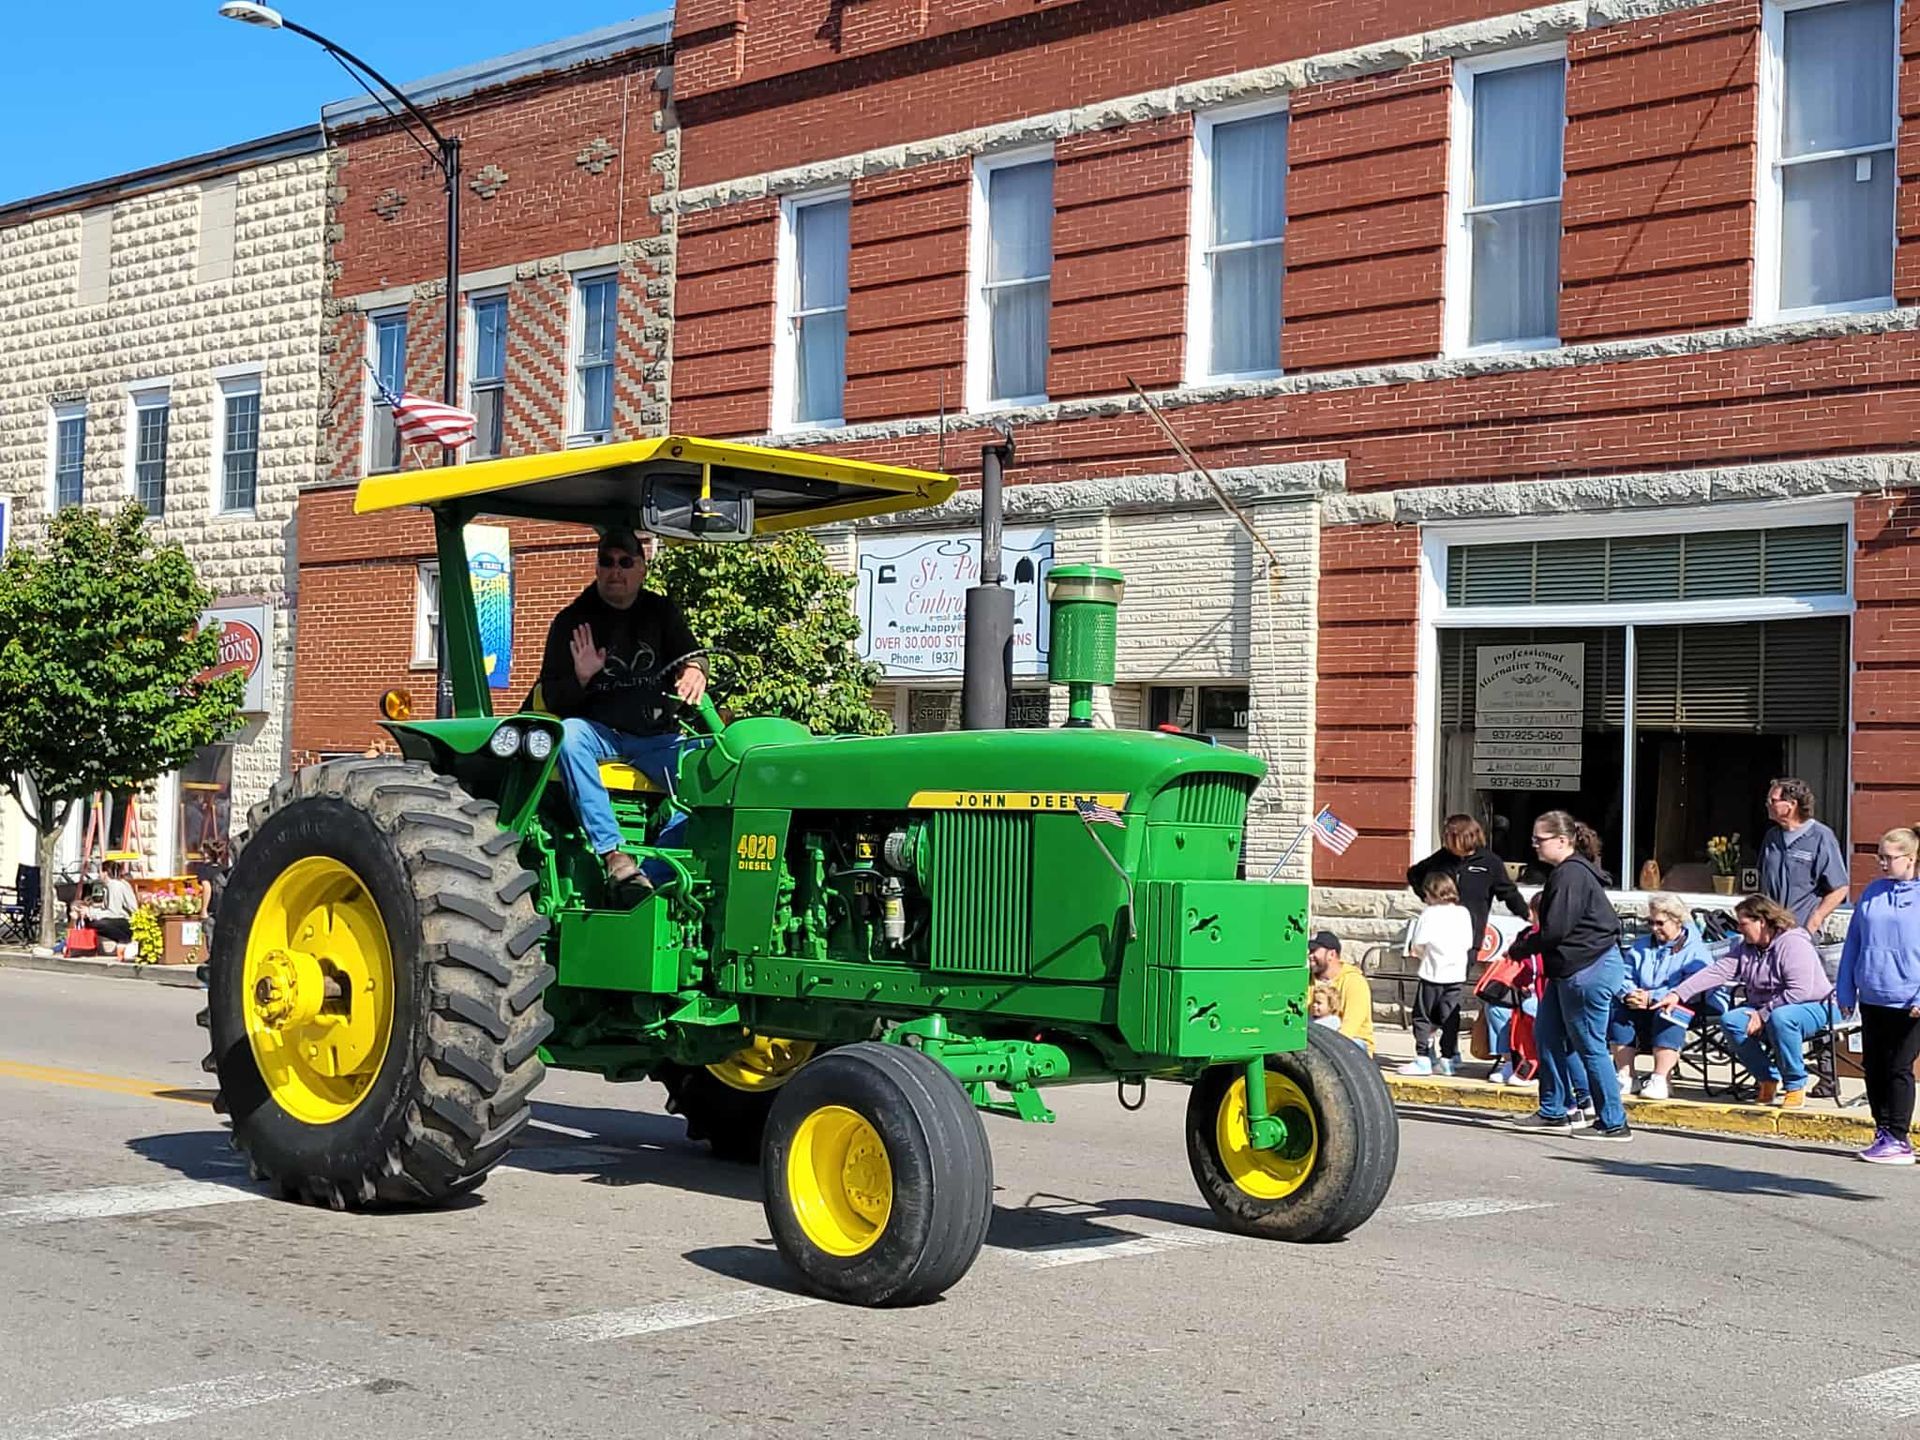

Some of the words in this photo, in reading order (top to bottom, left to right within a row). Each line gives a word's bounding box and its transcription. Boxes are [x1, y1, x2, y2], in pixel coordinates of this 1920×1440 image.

[219, 631, 241, 646] ARIS
[874, 637, 901, 650] OVER
[904, 635, 941, 650] 30,000
[218, 638, 253, 664] IONS
[891, 652, 924, 664] Phone:
[931, 651, 958, 665] (937)
[1493, 647, 1565, 665] Professional
[1479, 661, 1530, 690] Alternative
[1492, 730, 1564, 741] 937-925-0460
[1490, 777, 1561, 788] 937-869-3317
[955, 795, 1006, 807] JOHN
[737, 834, 777, 860] 4020
[738, 861, 773, 871] DIESEL
